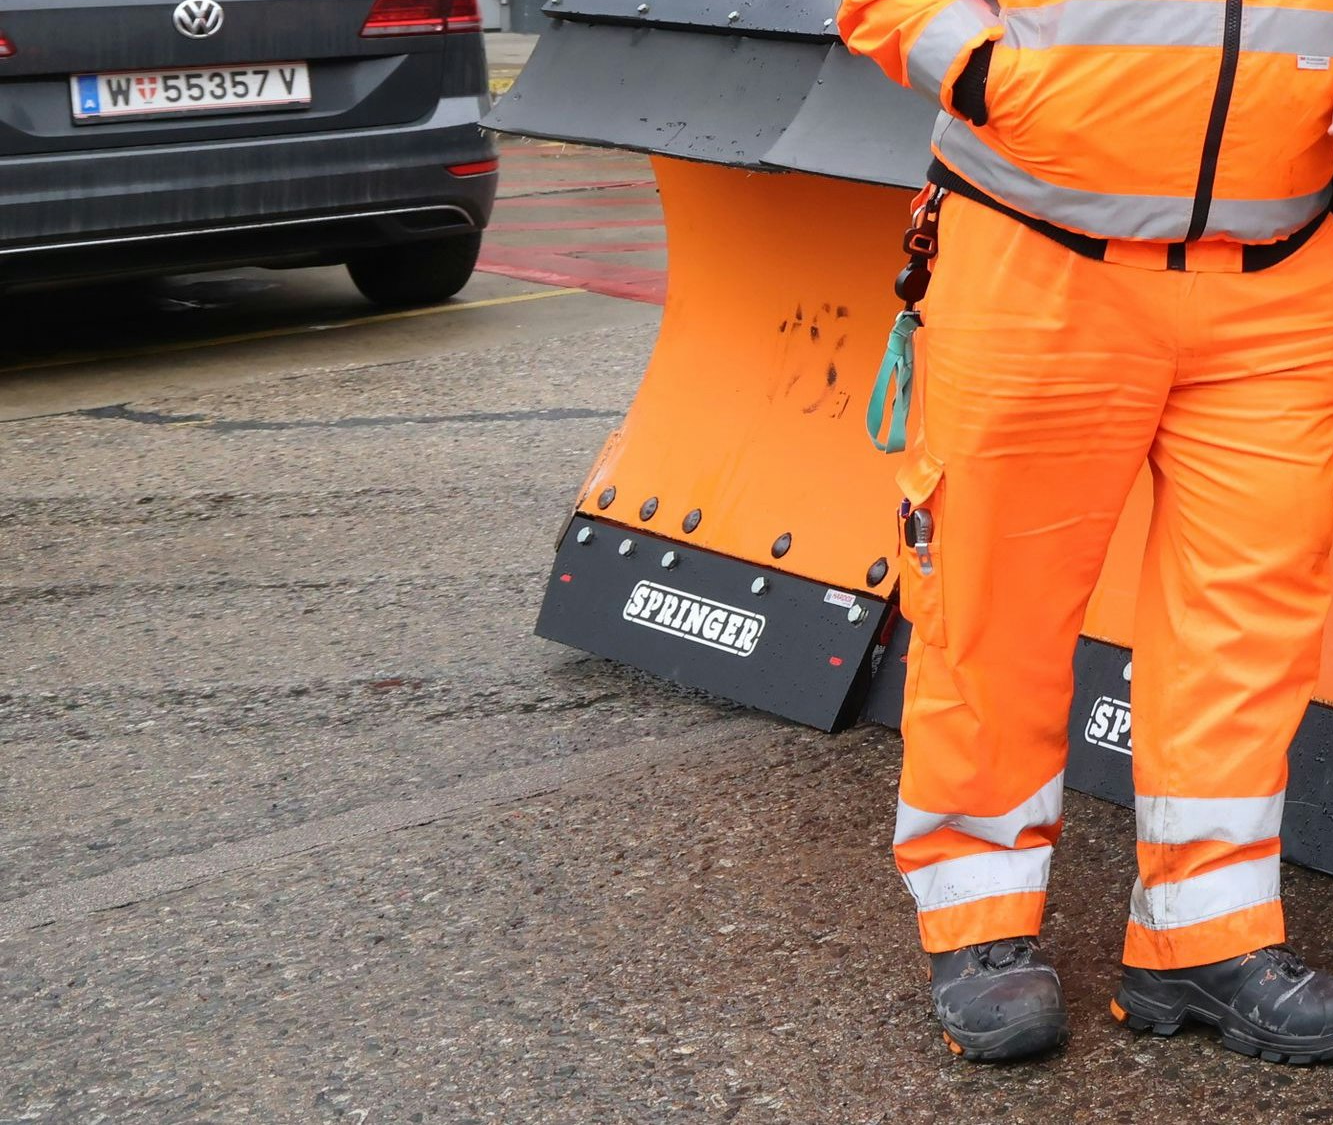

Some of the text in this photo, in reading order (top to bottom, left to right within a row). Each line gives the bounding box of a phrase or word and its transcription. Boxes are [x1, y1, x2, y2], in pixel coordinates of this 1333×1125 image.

[106, 67, 296, 107] W 55357 V
[626, 587, 761, 650] SPRINGER
[1089, 704, 1132, 746] SP
